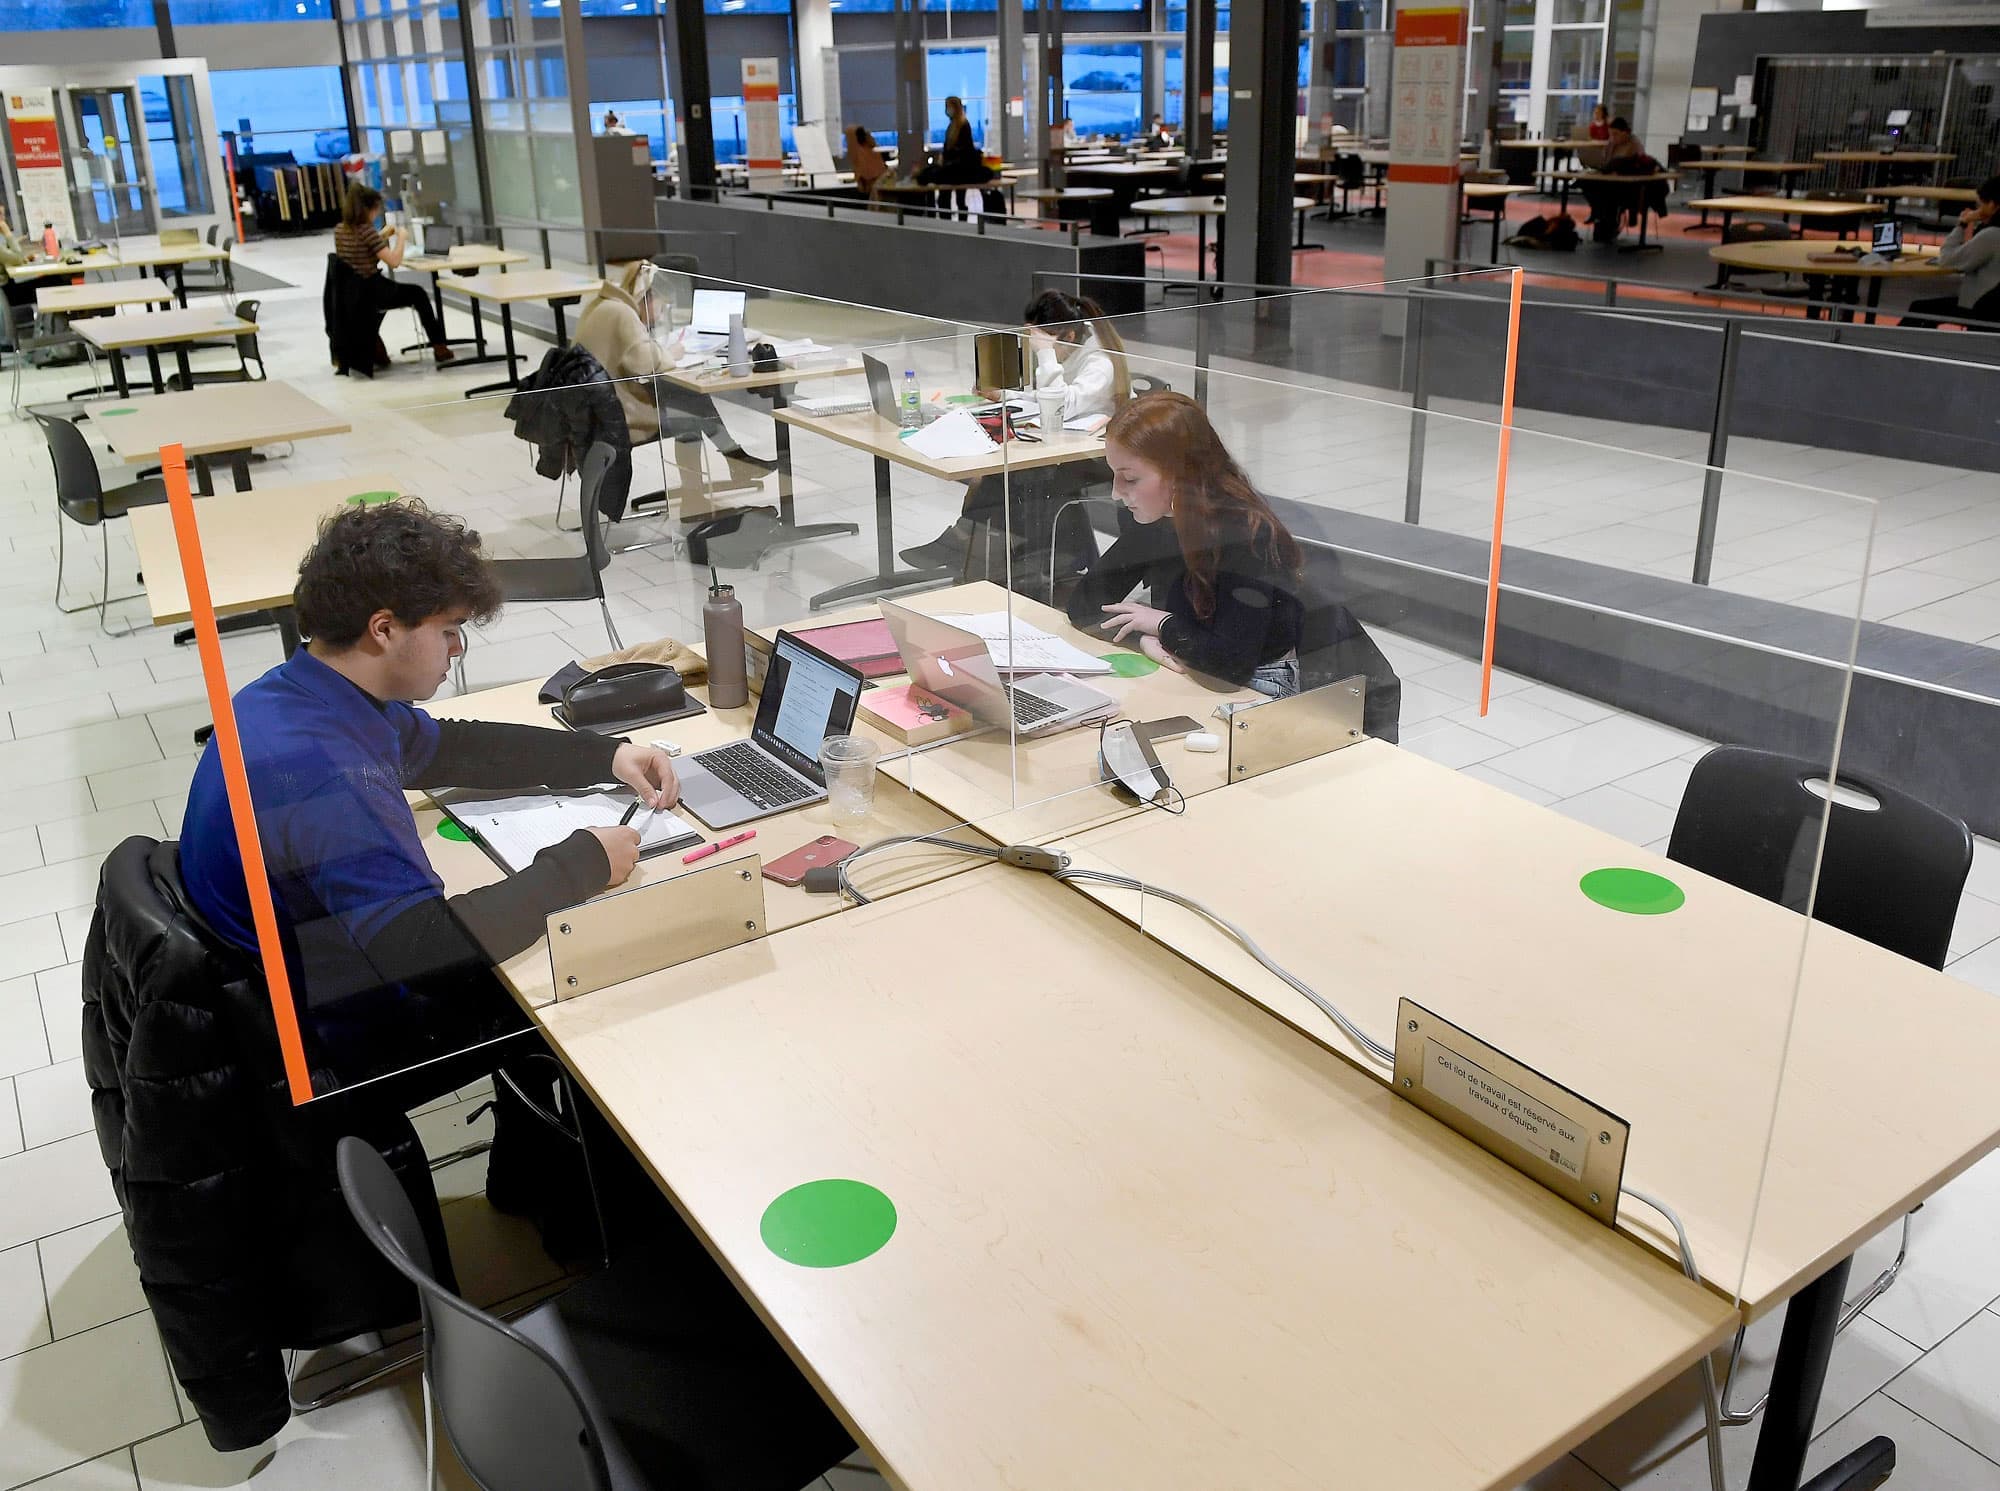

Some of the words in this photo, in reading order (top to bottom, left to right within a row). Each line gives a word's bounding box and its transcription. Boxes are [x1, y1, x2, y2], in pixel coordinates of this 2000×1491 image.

[1437, 1055, 1452, 1070] Cet
[1467, 1074, 1479, 1086] de
[1480, 1080, 1506, 1101] travail
[1507, 1098, 1521, 1111] est
[1523, 1106, 1557, 1131] réservé
[1558, 1128, 1576, 1143] aux
[1469, 1086, 1499, 1112] travaux
[1501, 1106, 1538, 1134] d'équipe
